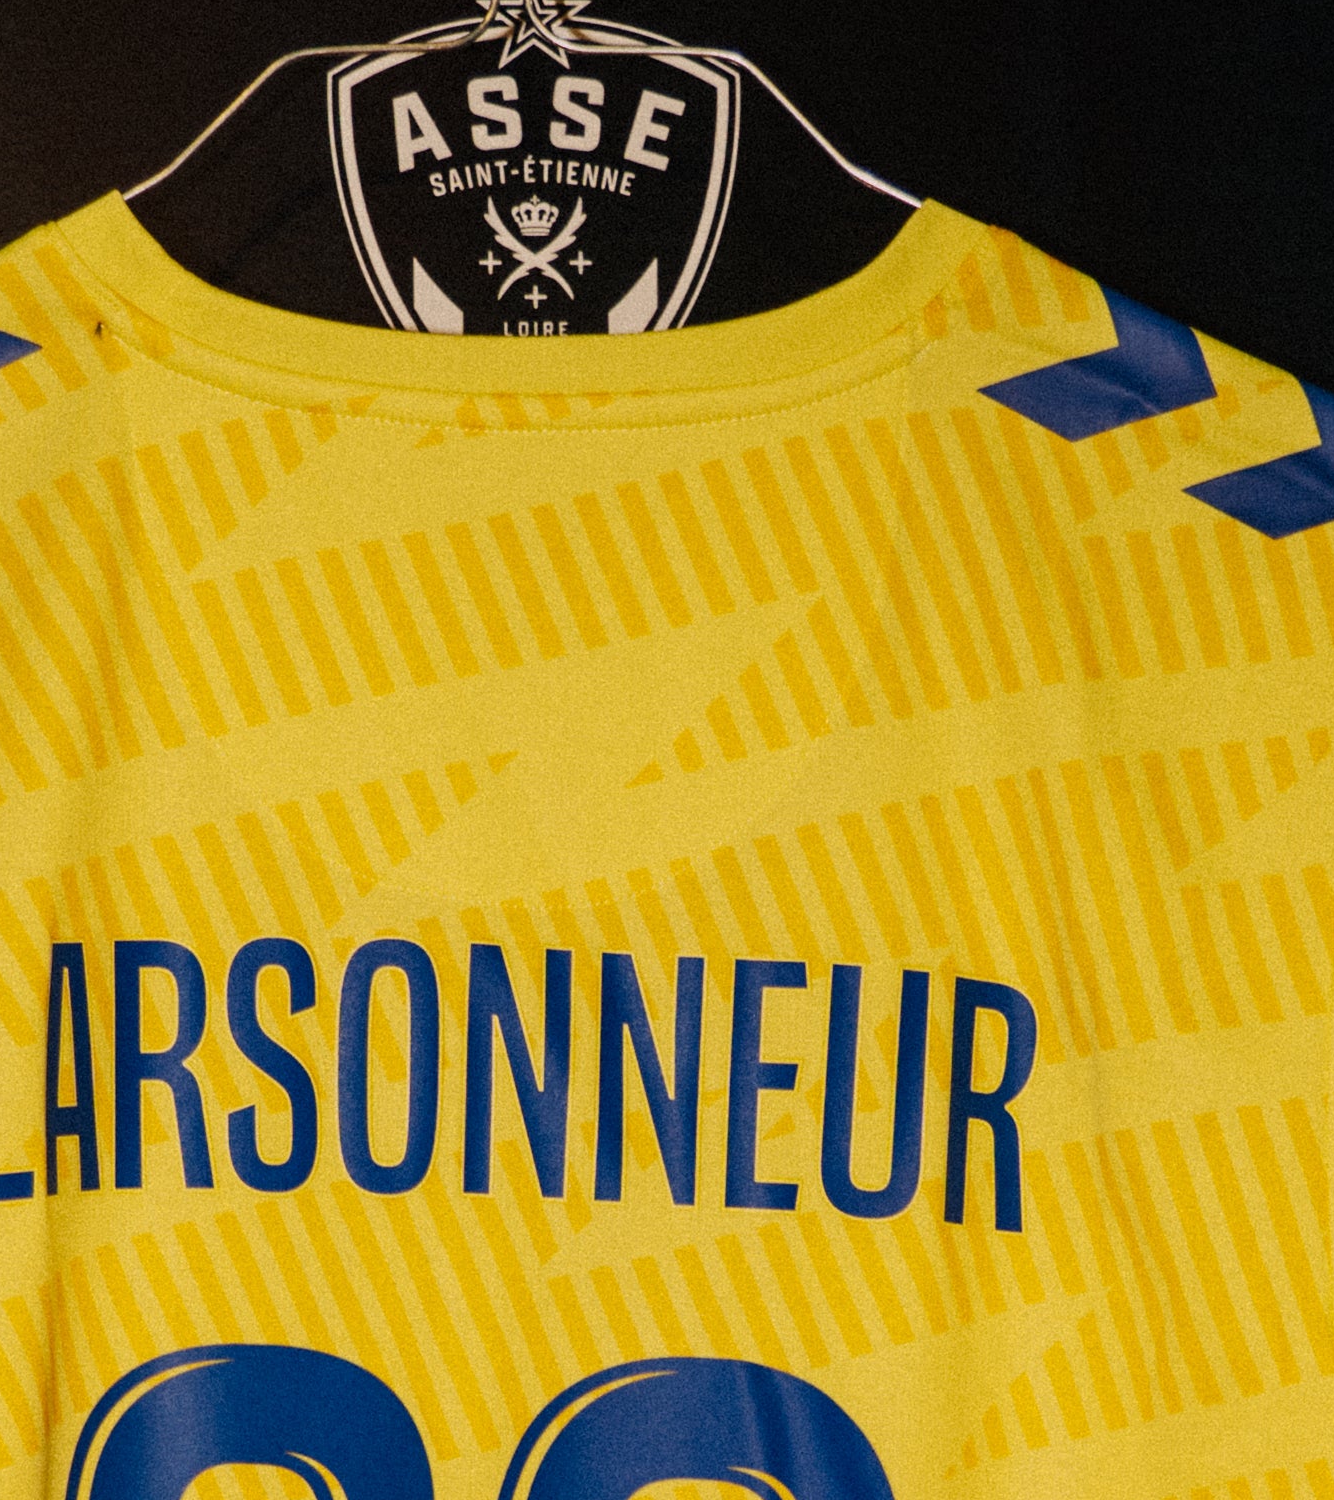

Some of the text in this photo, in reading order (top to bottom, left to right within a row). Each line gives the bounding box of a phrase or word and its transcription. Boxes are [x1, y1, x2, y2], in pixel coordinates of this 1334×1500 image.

[392, 75, 686, 172] ASSE
[428, 154, 636, 197] SAINT-ÉTIENNE
[503, 321, 569, 337] LOIRE
